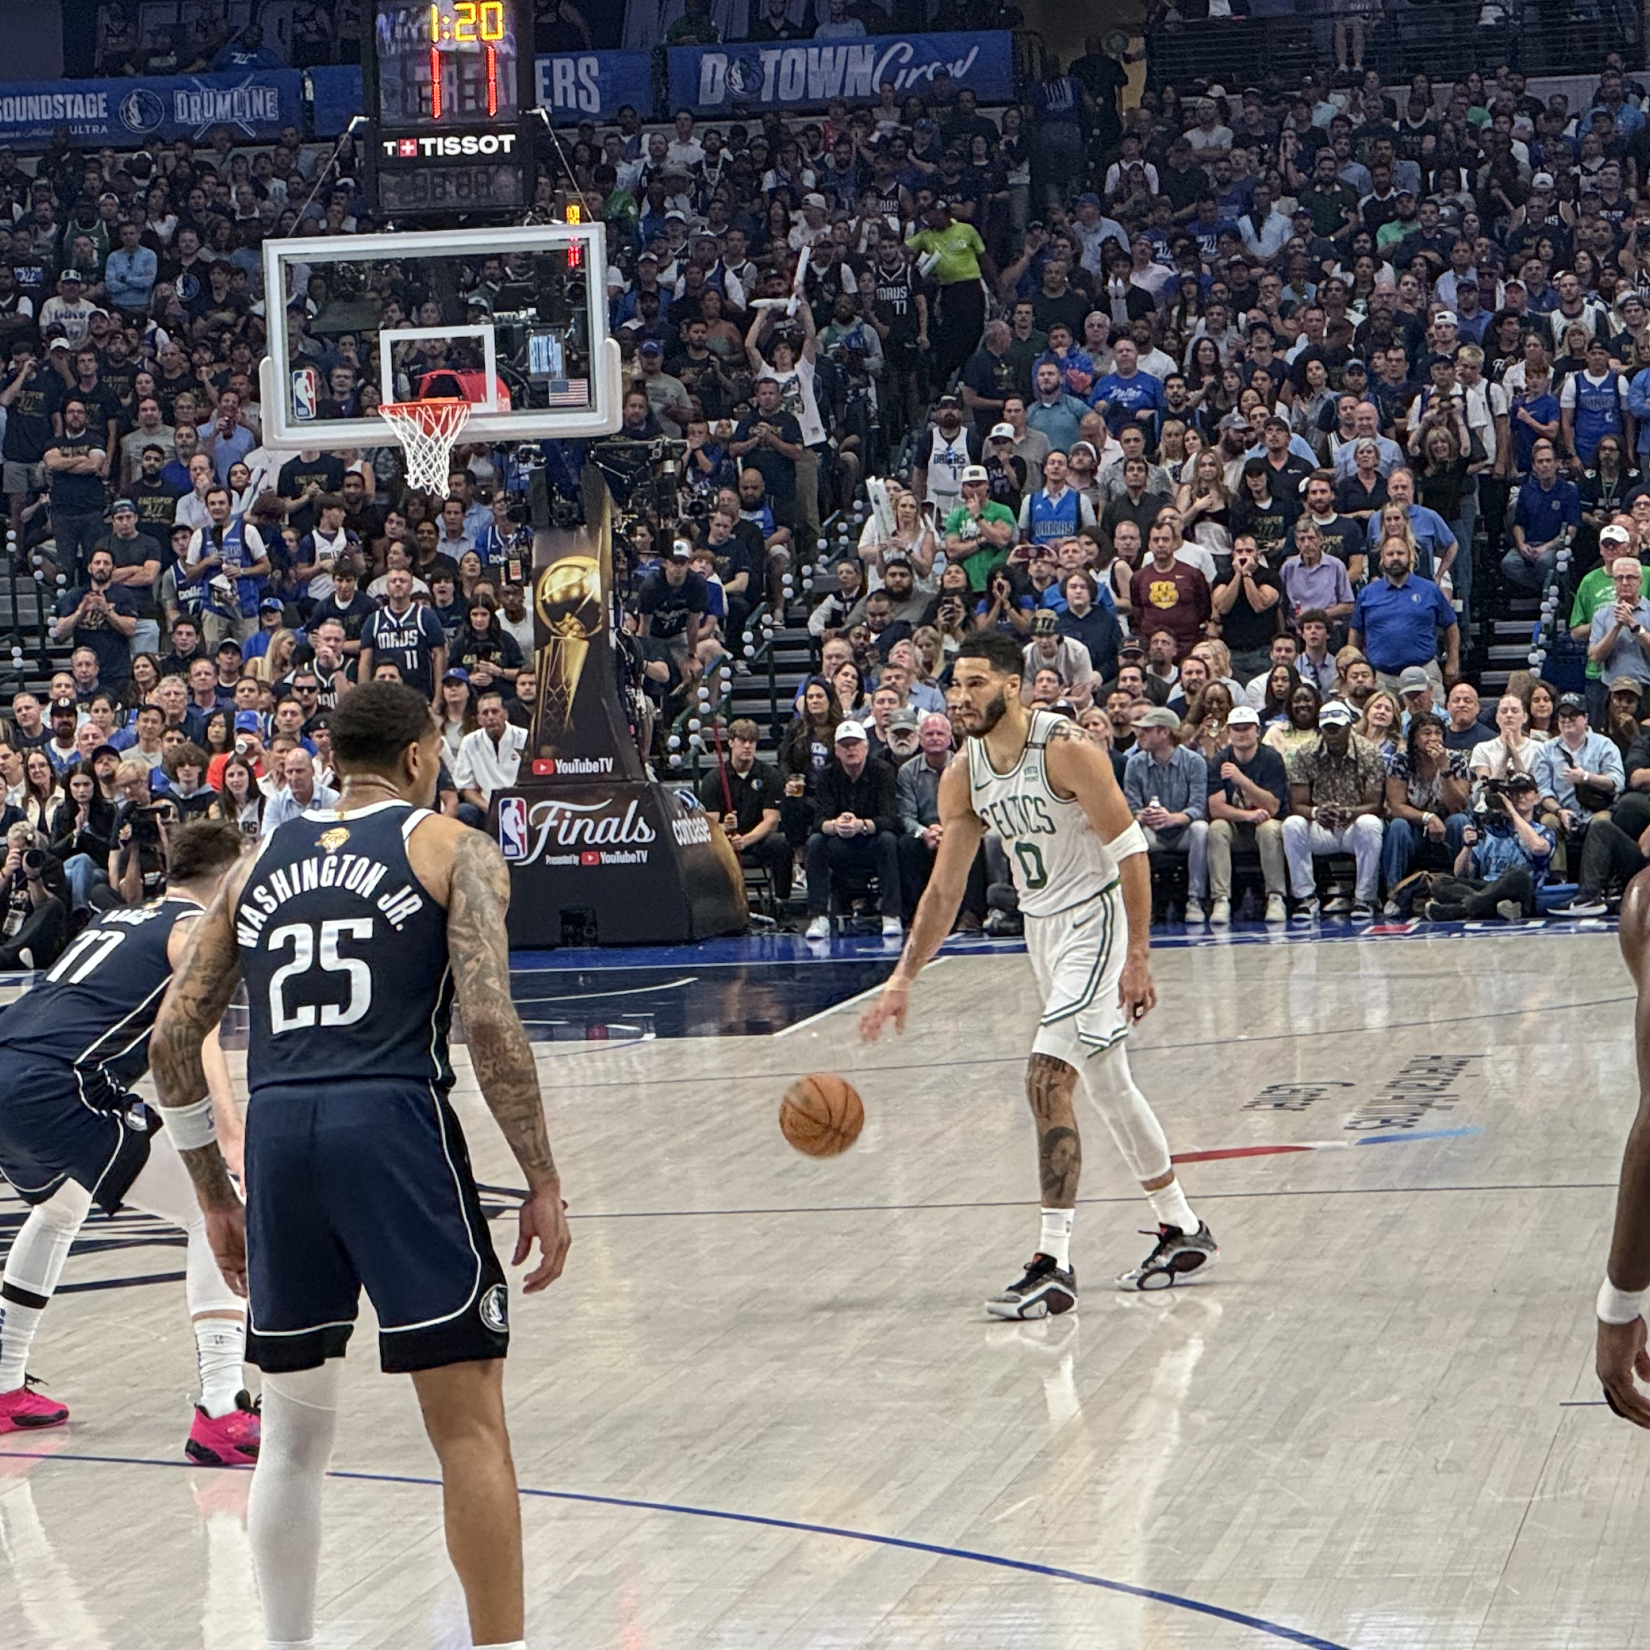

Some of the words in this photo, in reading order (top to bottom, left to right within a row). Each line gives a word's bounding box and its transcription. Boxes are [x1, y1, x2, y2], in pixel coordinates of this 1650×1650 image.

[430, 1, 504, 43] 1:20
[430, 44, 498, 119] 11
[535, 56, 600, 113] ERS
[760, 45, 874, 102] TOWN
[0, 92, 107, 122] OUNDSTAGE
[69, 125, 108, 135] ULTRA
[174, 86, 278, 124] DRUMLINE
[419, 134, 516, 156] TISSOT
[404, 650, 418, 669] 11
[513, 798, 656, 866] Finals
[1015, 841, 1048, 889] 0
[237, 854, 388, 949] WASHINGTON
[377, 884, 423, 932] JR.
[46, 929, 126, 985] 77
[268, 917, 374, 1035] 25
